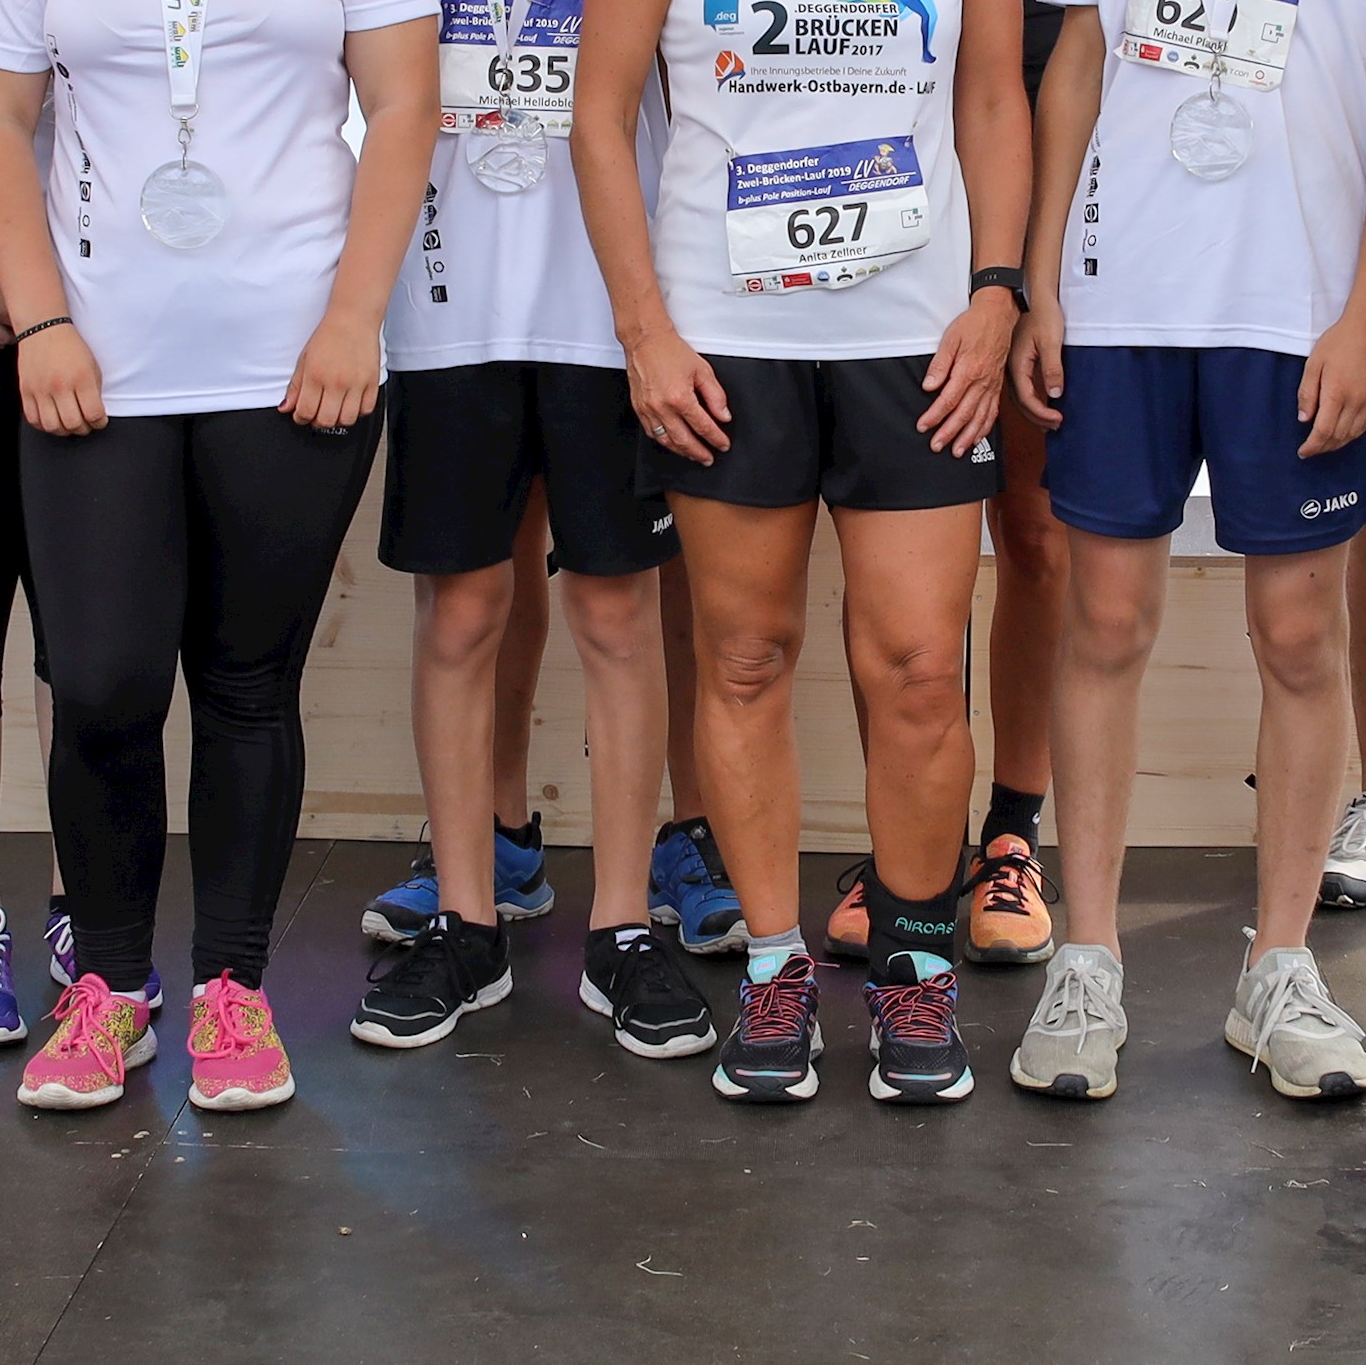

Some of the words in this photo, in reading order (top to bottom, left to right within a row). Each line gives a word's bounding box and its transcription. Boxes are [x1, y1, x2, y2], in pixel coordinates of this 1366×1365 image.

[450, 4, 458, 14] 3.
[536, 18, 559, 29] 2019
[750, 0, 790, 55] 2
[795, 15, 899, 37] BRÜCKEN
[469, 32, 487, 41] Pole
[1153, 27, 1194, 45] Michael
[1196, 37, 1228, 51] Plankl
[795, 38, 851, 55] LAUF
[852, 45, 884, 56] 2017
[488, 54, 570, 93] 635
[750, 66, 767, 76] Ihre
[769, 66, 841, 78] Innungsbetriebe
[847, 67, 872, 76] Deine
[874, 67, 907, 77] Zukunft
[729, 80, 906, 96] Handwerk-Ostbayern.de
[479, 95, 520, 106] Michael
[736, 165, 745, 176] 3.
[747, 156, 819, 174] Deggendorfer
[737, 171, 826, 190] Zwei-Brücken-Lauf
[828, 166, 852, 178] 2019
[854, 159, 874, 179] LV
[848, 176, 910, 192] DEGGENDORF
[738, 193, 762, 205] b-plus
[762, 191, 780, 202] Pole
[781, 185, 832, 199] Position-Lauf
[787, 202, 868, 249] 627
[799, 251, 828, 263] Anita
[830, 246, 867, 259] Zellner
[1323, 491, 1358, 513] JAKO
